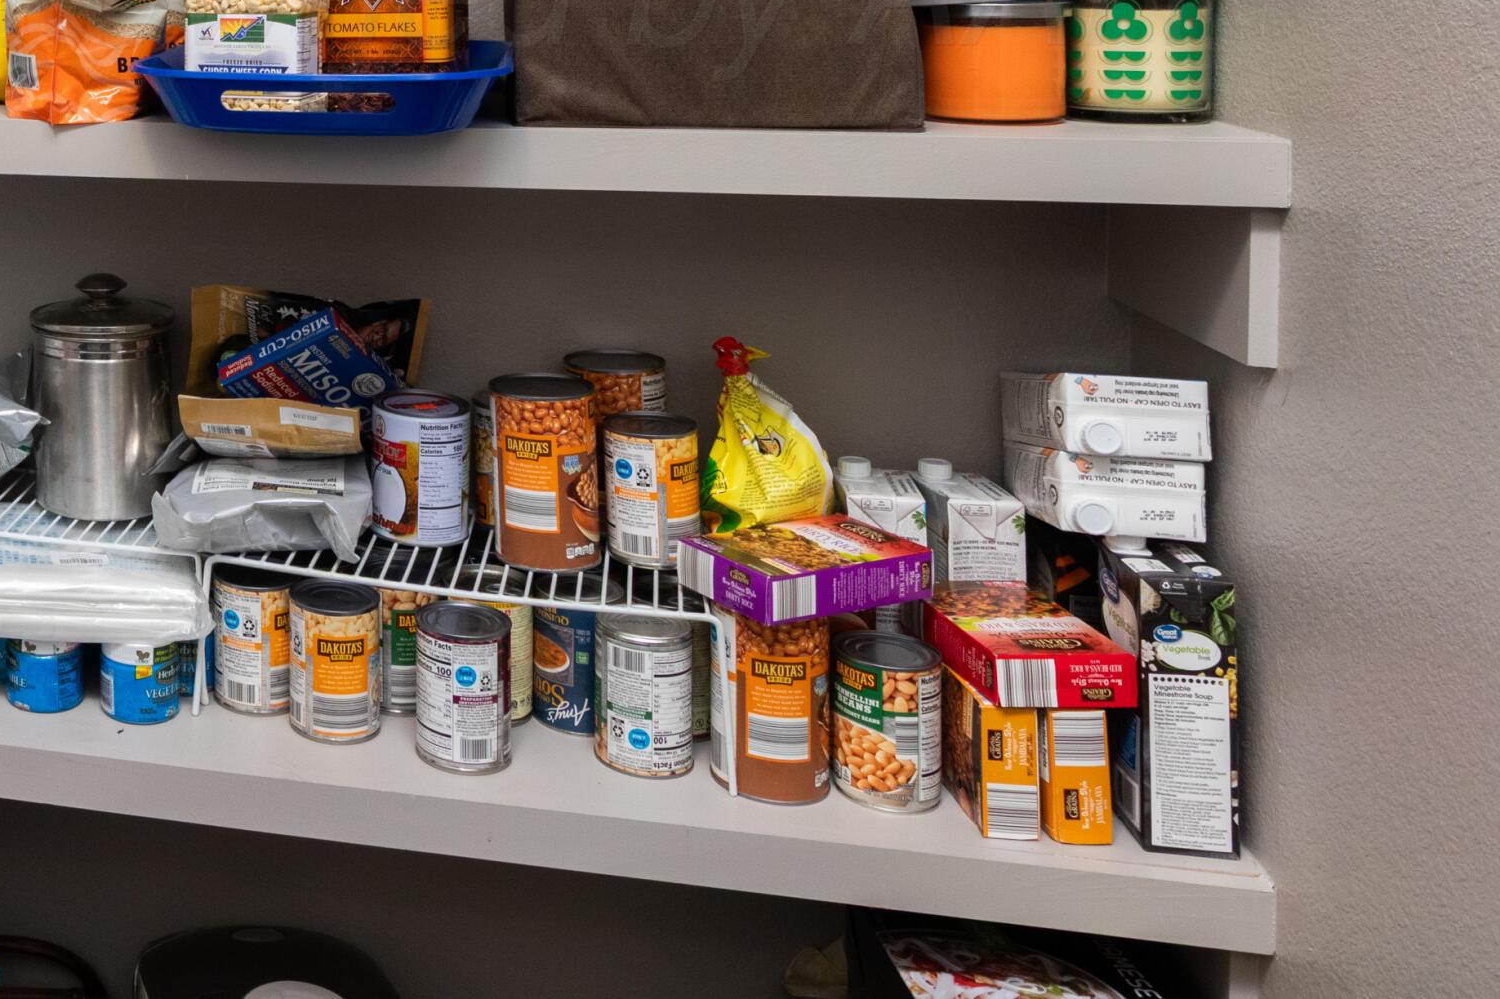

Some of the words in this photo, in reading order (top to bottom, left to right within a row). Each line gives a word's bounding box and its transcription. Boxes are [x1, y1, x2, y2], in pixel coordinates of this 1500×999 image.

[327, 22, 376, 34] TOMATO
[378, 22, 417, 33] FLAKES
[258, 314, 330, 359] MISO-CUP
[225, 360, 253, 377] Reduced
[252, 371, 283, 399] Sodium
[262, 365, 300, 398] Reduced
[1083, 395, 1097, 403] TAB!
[1150, 400, 1169, 408] OPEN
[1183, 401, 1201, 409] EASY
[507, 438, 550, 454] DAKOTA'S
[1094, 475, 1110, 483] PULL
[1130, 478, 1144, 486] CAP
[1146, 479, 1166, 487] OPEN
[1178, 481, 1197, 490] EASY
[725, 591, 740, 604] DIRTY
[741, 597, 754, 609] RICE
[1157, 628, 1177, 636] Great
[320, 642, 362, 654] DAKOTA'S
[434, 640, 452, 650] Facts
[1164, 646, 1210, 655] Vegetable
[436, 665, 452, 676] 100
[755, 662, 804, 677] DAKOTA'S
[1070, 664, 1083, 672] RICE
[1089, 664, 1108, 672] BEANS
[1109, 664, 1122, 672] RED
[1082, 688, 1112, 697] GRAINS
[838, 695, 872, 714] BEANS
[546, 698, 590, 726] Amy's
[861, 715, 881, 725] BEANS
[654, 736, 667, 744] 100
[993, 732, 1001, 759] GRAINS
[1019, 728, 1028, 767] JAMBALAYA
[653, 761, 672, 769] Facts
[1069, 791, 1078, 818] GRAINS
[1094, 786, 1106, 824] JAMBALAYA
